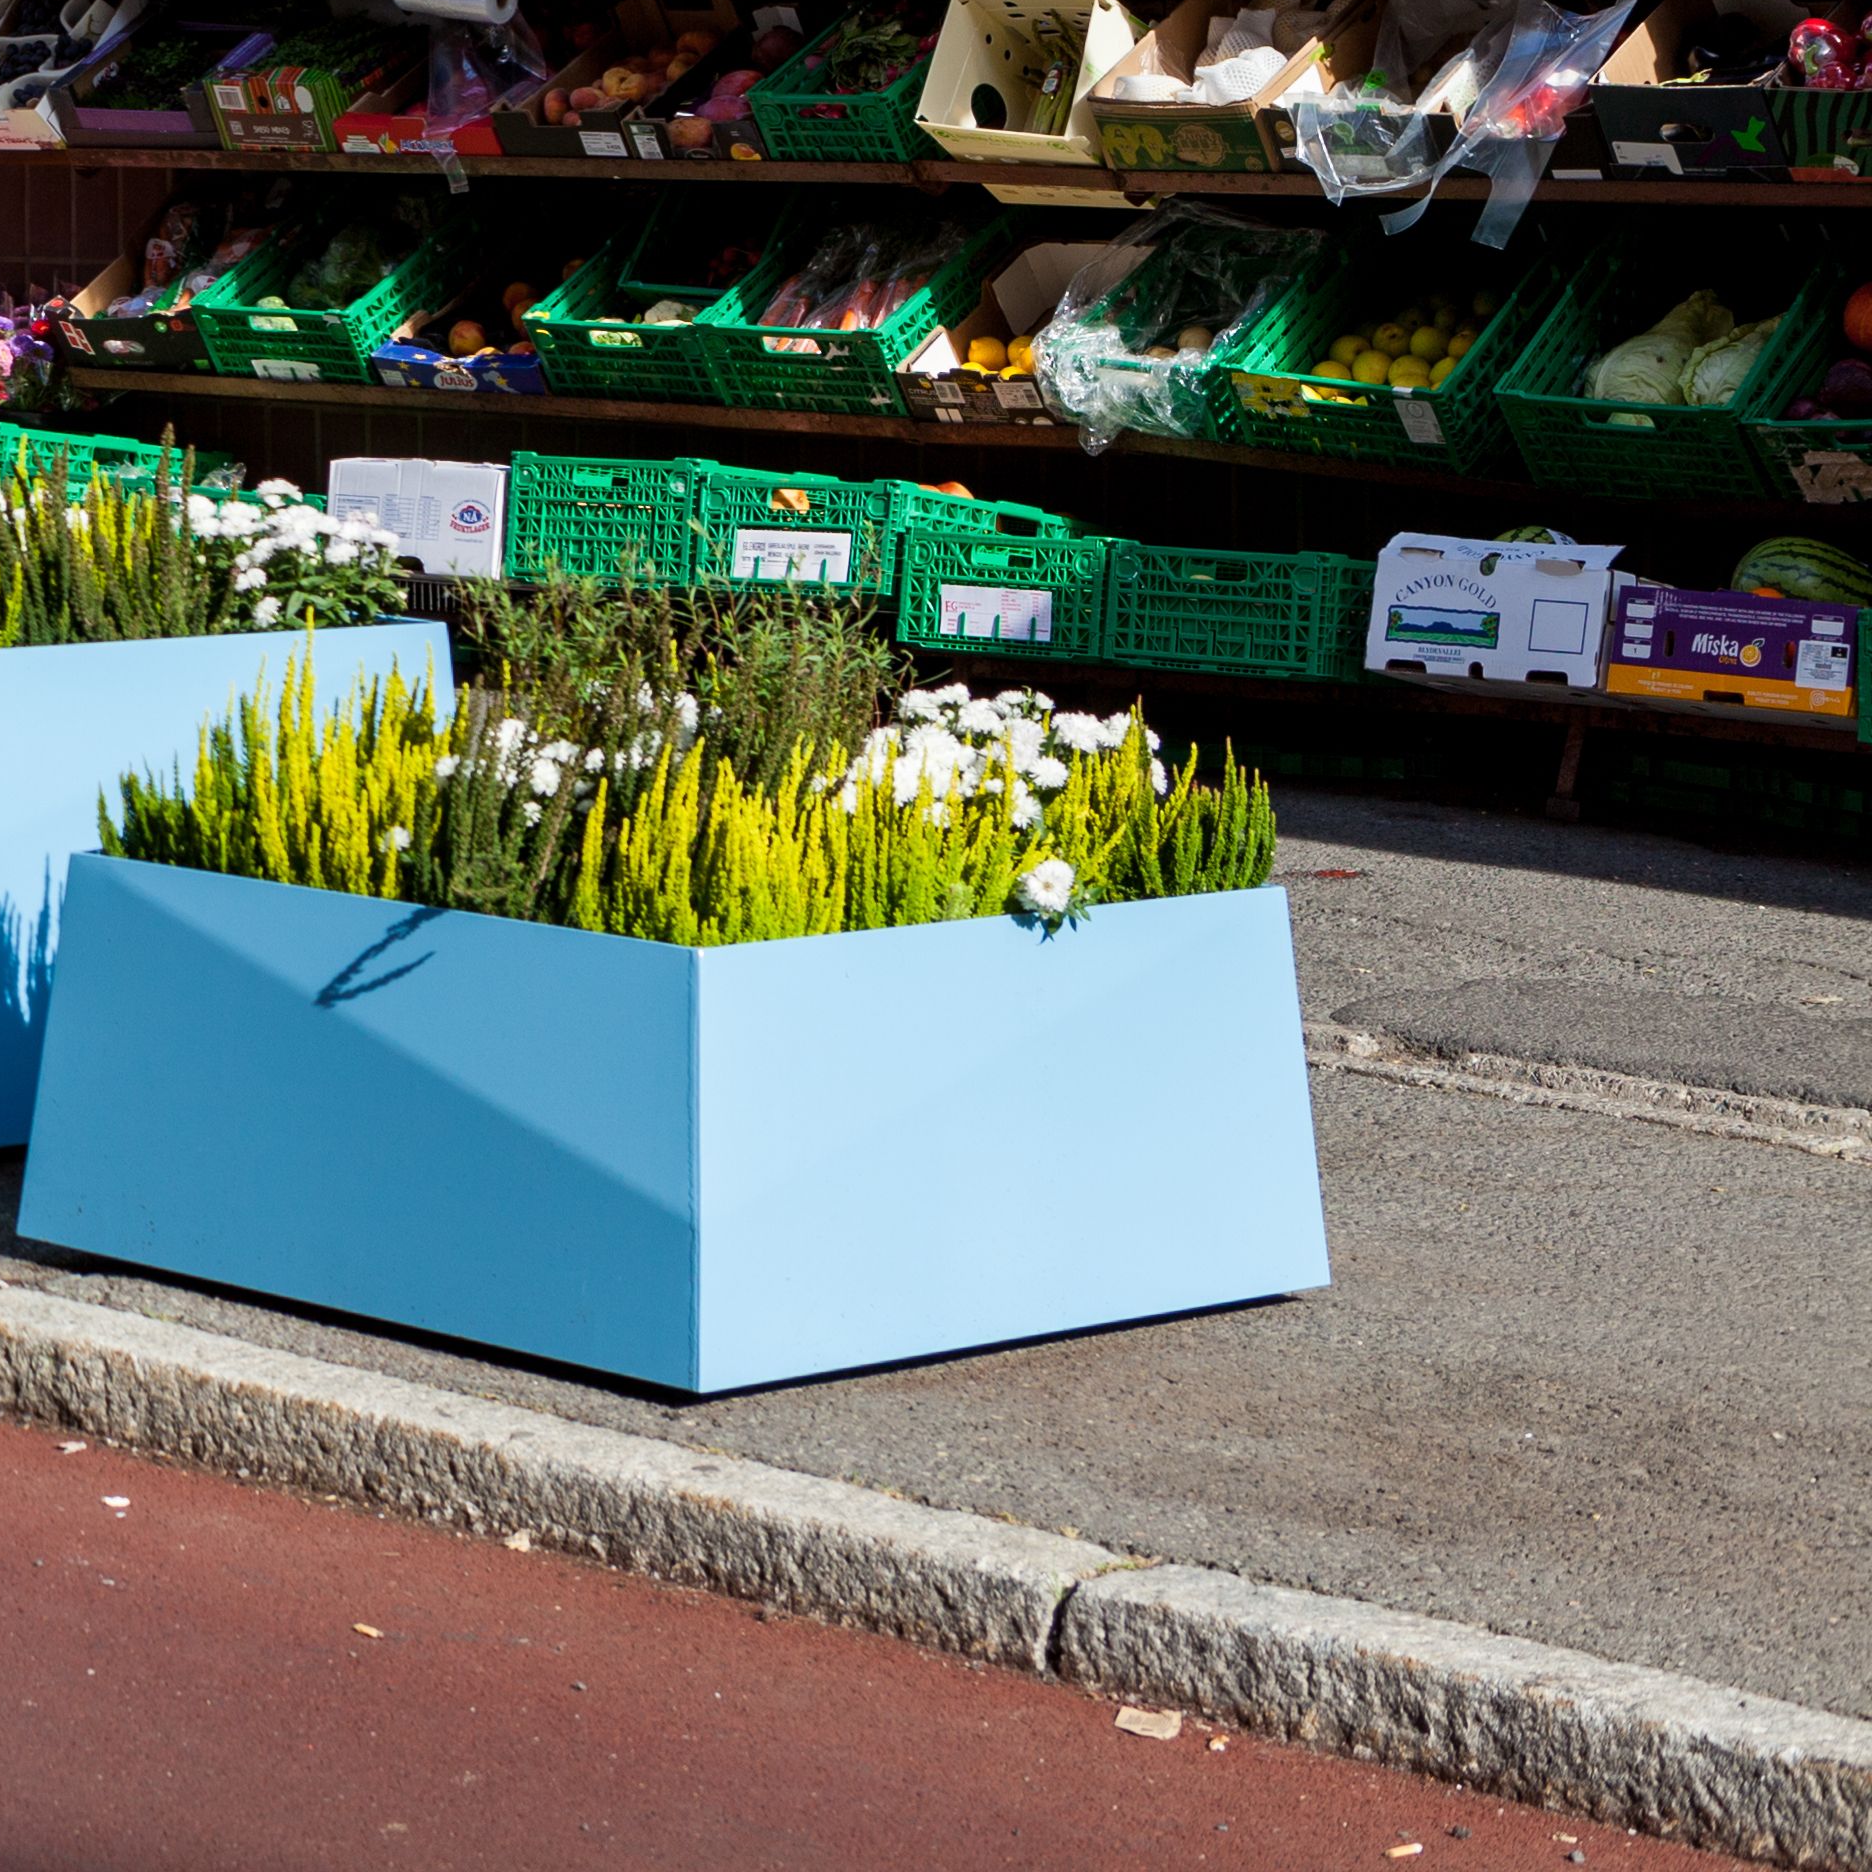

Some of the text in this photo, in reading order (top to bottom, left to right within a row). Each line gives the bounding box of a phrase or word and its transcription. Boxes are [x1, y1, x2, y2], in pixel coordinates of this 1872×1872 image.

[439, 375, 475, 388] JULIUS
[1395, 573, 1498, 610] CANYON GOLD
[1691, 632, 1740, 657] Miska
